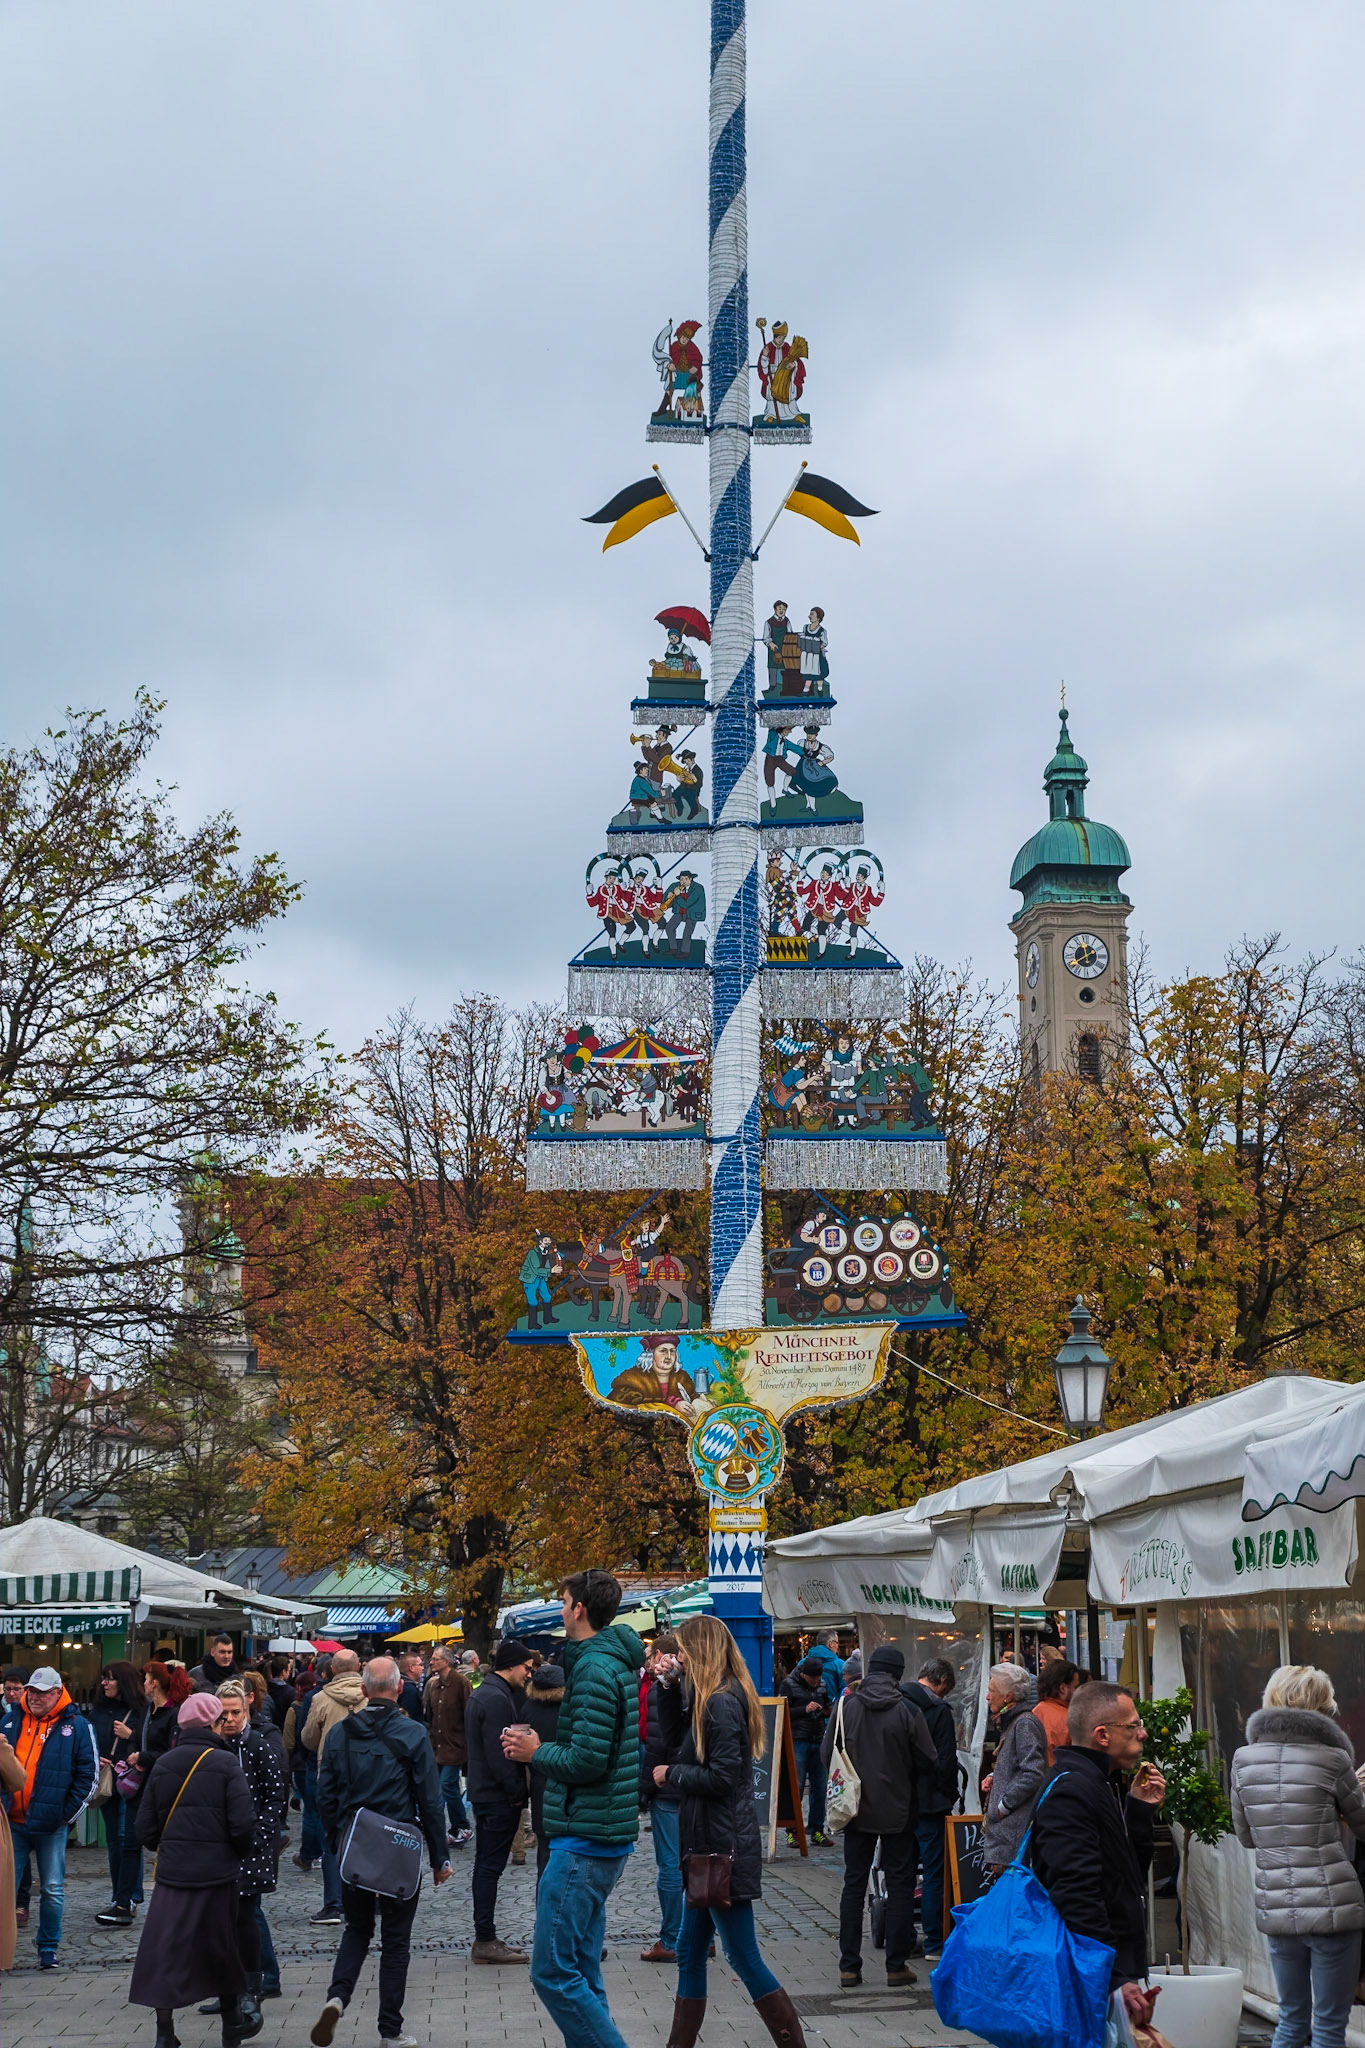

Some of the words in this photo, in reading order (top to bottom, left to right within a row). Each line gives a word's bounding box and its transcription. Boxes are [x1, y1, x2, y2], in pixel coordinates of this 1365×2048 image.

[812, 1270, 823, 1280] HB
[755, 1350, 875, 1366] REINHEITSGEBOT
[849, 1363, 867, 1375] 1487
[1232, 1526, 1319, 1575] SAFTBAR
[1001, 1563, 1040, 1593] SAFTBAR
[726, 1583, 745, 1591] 2017
[24, 1616, 62, 1634] ECKE
[67, 1620, 91, 1633] seit
[94, 1616, 123, 1630] 1903
